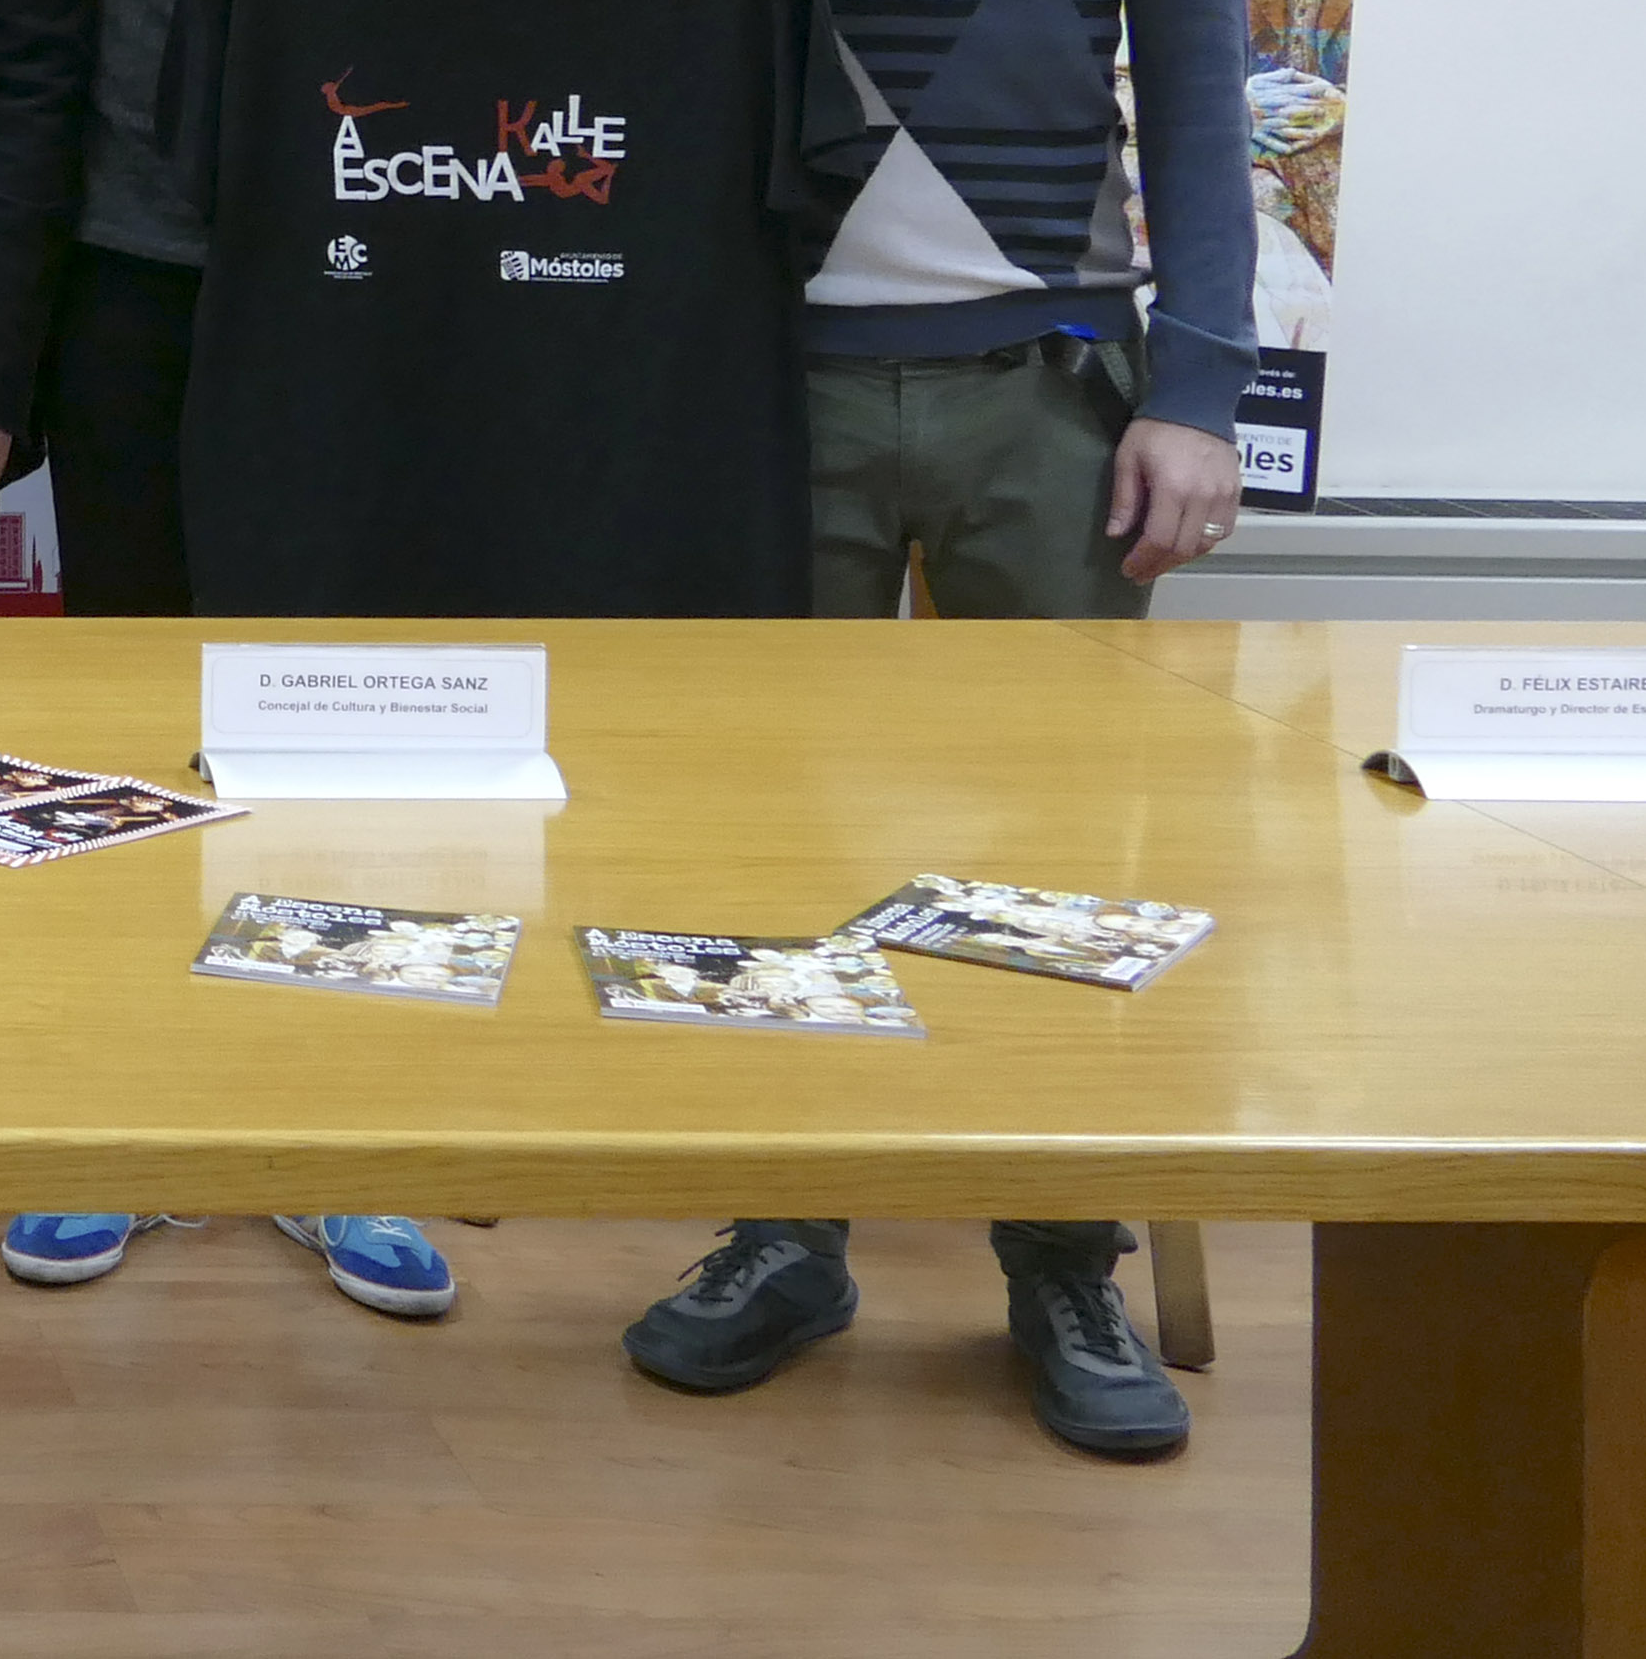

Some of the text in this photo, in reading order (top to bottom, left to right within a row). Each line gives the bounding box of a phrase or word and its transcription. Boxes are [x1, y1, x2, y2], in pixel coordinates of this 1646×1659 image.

[334, 115, 364, 157] A
[497, 94, 626, 159] KALLE
[334, 145, 524, 201] ESCENA
[530, 256, 624, 278] Móstoles
[259, 674, 488, 691] D. GABRIEL ORTEGA SANZ
[1500, 677, 1517, 691] D.
[1523, 674, 1571, 691] FÉLIX
[258, 700, 488, 715] Concejal de Cultura y Bienestar Social
[1474, 704, 1547, 716] Dramaturgo
[1549, 706, 1557, 716] y
[1560, 704, 1609, 715] Director
[1613, 704, 1628, 715] de
